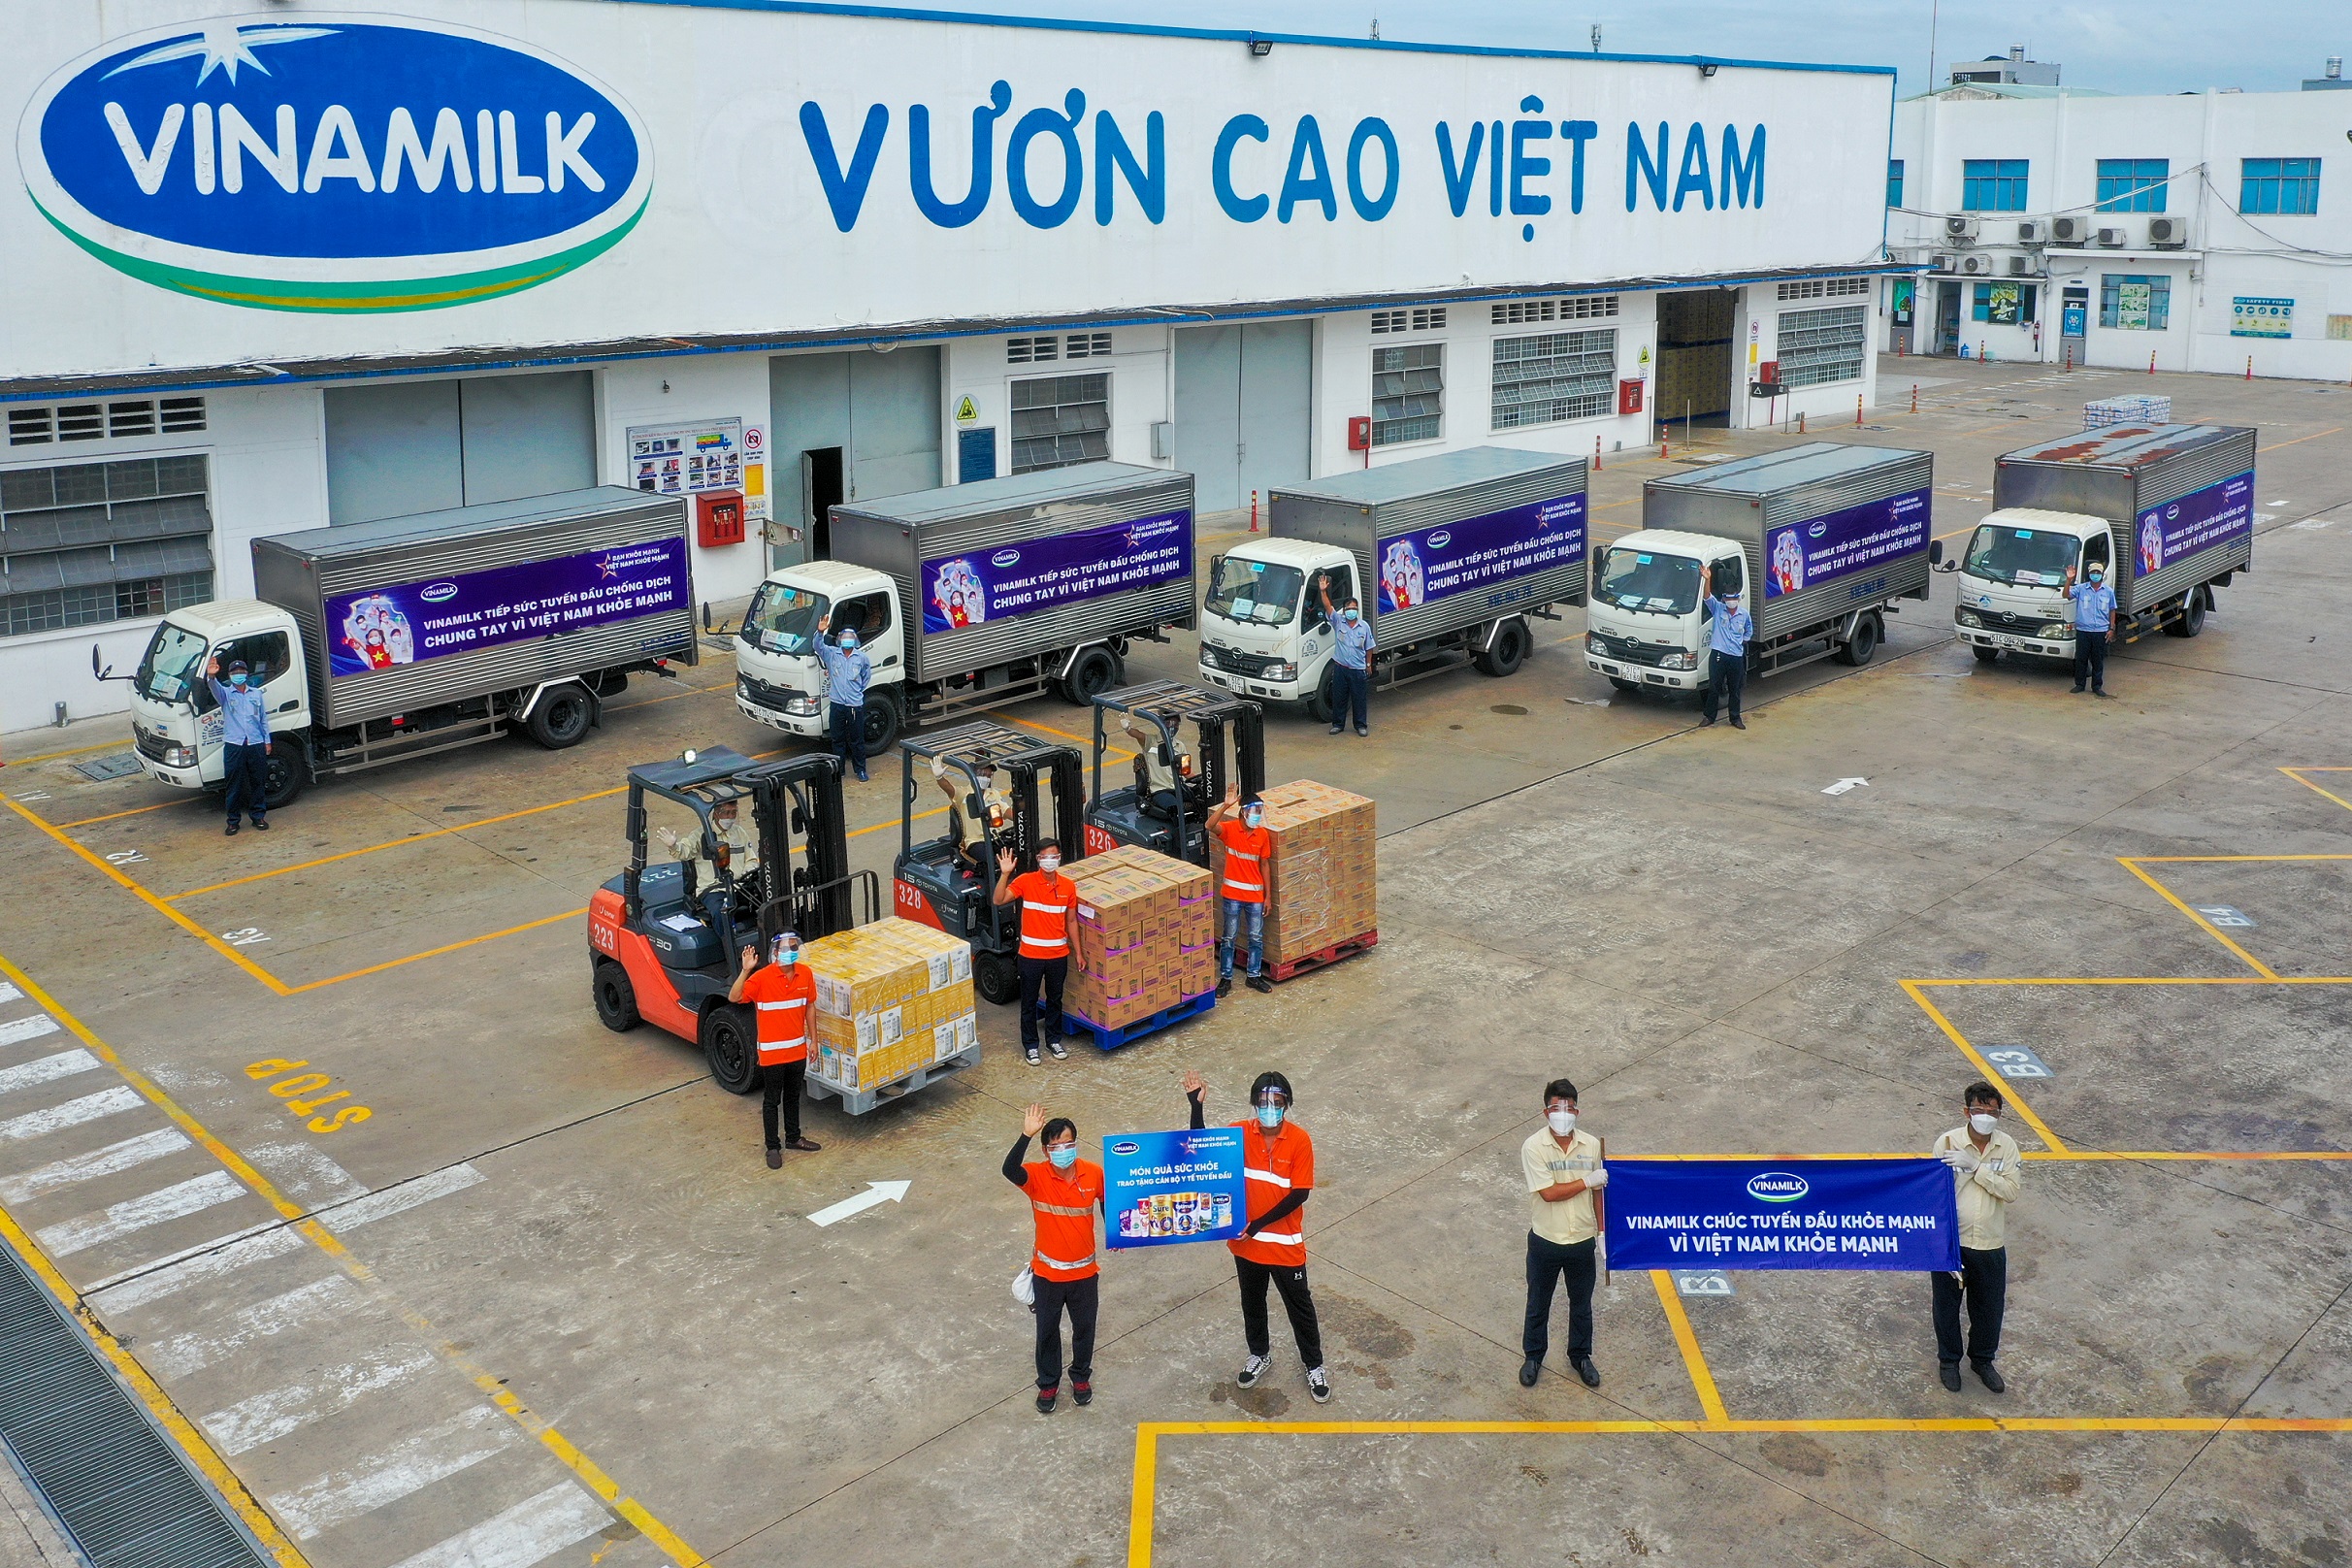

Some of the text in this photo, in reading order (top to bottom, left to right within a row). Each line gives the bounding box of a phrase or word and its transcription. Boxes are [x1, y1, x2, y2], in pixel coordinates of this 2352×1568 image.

[104, 102, 605, 195] VINAMILK
[799, 79, 1767, 242] VƯƠN CAO VIỆT NAM
[1428, 558, 1463, 574] VINAMILK
[1465, 551, 1482, 565] TIẾP
[1483, 549, 1498, 561] SỨC
[1500, 541, 1522, 556] TUYẾN
[1540, 533, 1563, 545] CHỐNG
[1565, 529, 1582, 540] DỊCH
[1429, 535, 1449, 543] VINAMILK
[994, 576, 1036, 593] VINAMILK
[1038, 570, 1058, 583] TIẾP
[1061, 567, 1078, 578] SỨC
[1081, 559, 1108, 574] TUYẾN
[1129, 550, 1158, 564] CHỐNG
[1160, 547, 1179, 558] DỊCH
[1427, 543, 1581, 591] CHUNG TAY VÌ VIỆT NAM KHỎE MẠNH
[1808, 563, 1831, 576] CHUNG
[1833, 558, 1846, 569] TAY
[1847, 553, 1854, 565] VÌ
[1855, 550, 1870, 563] VIỆT
[1871, 546, 1884, 557] NAM
[424, 586, 455, 598] VINAMILK
[994, 561, 1179, 609] CHUNG TAY VÌ VIỆT NAM KHỎE MẠNH
[424, 577, 670, 630] VINAMILK TIẾP SỨC TUYẾN ĐẦU CHỐNG DỊCH
[425, 591, 672, 648] CHUNG TAY VÌ VIỆT NAM KHỎE MẠNH
[1090, 829, 1111, 850] 326
[1094, 819, 1127, 836] 15 TOYOTA
[904, 873, 938, 893] 15 TOYOTA
[898, 884, 921, 909] 328
[2199, 907, 2251, 927] B4
[594, 924, 614, 951] 223
[656, 938, 672, 952] 30
[1988, 1051, 2046, 1077] B3
[245, 1059, 373, 1133] STOP
[1129, 1160, 1219, 1176] MÓN QUÀ SỨC KHỎE
[1136, 1178, 1154, 1187] TẶNG
[1171, 1175, 1181, 1185] BỘ
[1196, 1172, 1218, 1181] TUYẾN
[1753, 1181, 1803, 1192] VINAMILK
[1626, 1210, 1936, 1233] VINAMILK CHÚC TUYẾN ĐẦU KHỎE MẠNH
[1669, 1230, 1898, 1258] VÌ VIỆT NAM KHỎE MẠNH
